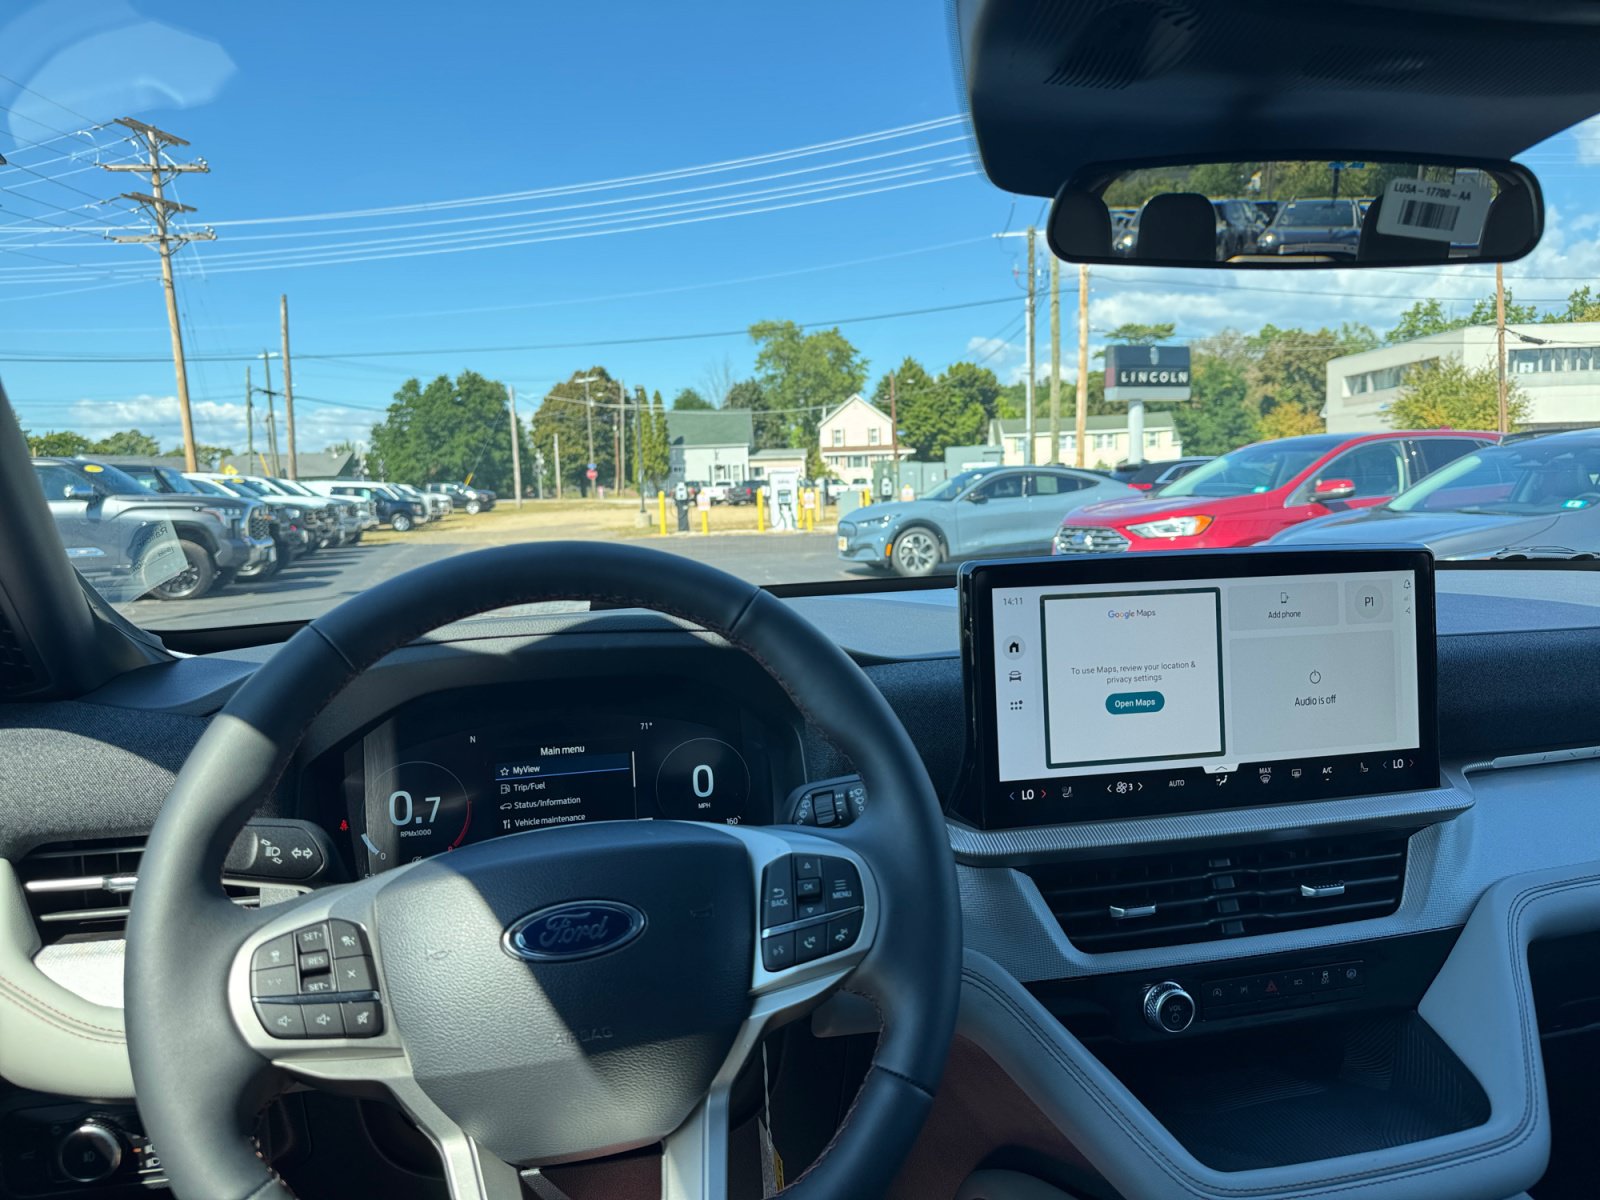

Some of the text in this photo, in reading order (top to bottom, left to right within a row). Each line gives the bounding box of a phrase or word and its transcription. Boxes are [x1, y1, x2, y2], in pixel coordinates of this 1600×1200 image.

[1120, 371, 1189, 383] LINCOLN
[1003, 597, 1023, 606] 14:11
[1364, 596, 1374, 607] P1
[1107, 609, 1156, 619] Google Maps
[1268, 610, 1301, 620] Add phone
[1071, 660, 1197, 675] To use Maps, review your location &
[1106, 673, 1163, 685] privacy settings
[1114, 698, 1156, 709] Open Maps
[1294, 693, 1337, 707] Audio is off
[469, 735, 477, 743] N
[540, 745, 585, 756] Main menu
[1392, 758, 1404, 769] LO
[512, 765, 541, 775] MyView
[1322, 766, 1333, 775] A/C
[513, 781, 546, 792] Trip/Fuel
[692, 764, 714, 798] 0
[1168, 779, 1185, 787] AUTO
[1128, 783, 1134, 791] 3
[1021, 789, 1035, 800] LO
[388, 790, 441, 826] 0.7
[513, 797, 582, 810] Status/Information
[514, 814, 586, 827] Vehicle maintenance
[726, 817, 739, 825] 160
[832, 890, 852, 899] MENU
[771, 899, 789, 907] BACK
[539, 911, 609, 947] Ford
[308, 957, 325, 966] RES
